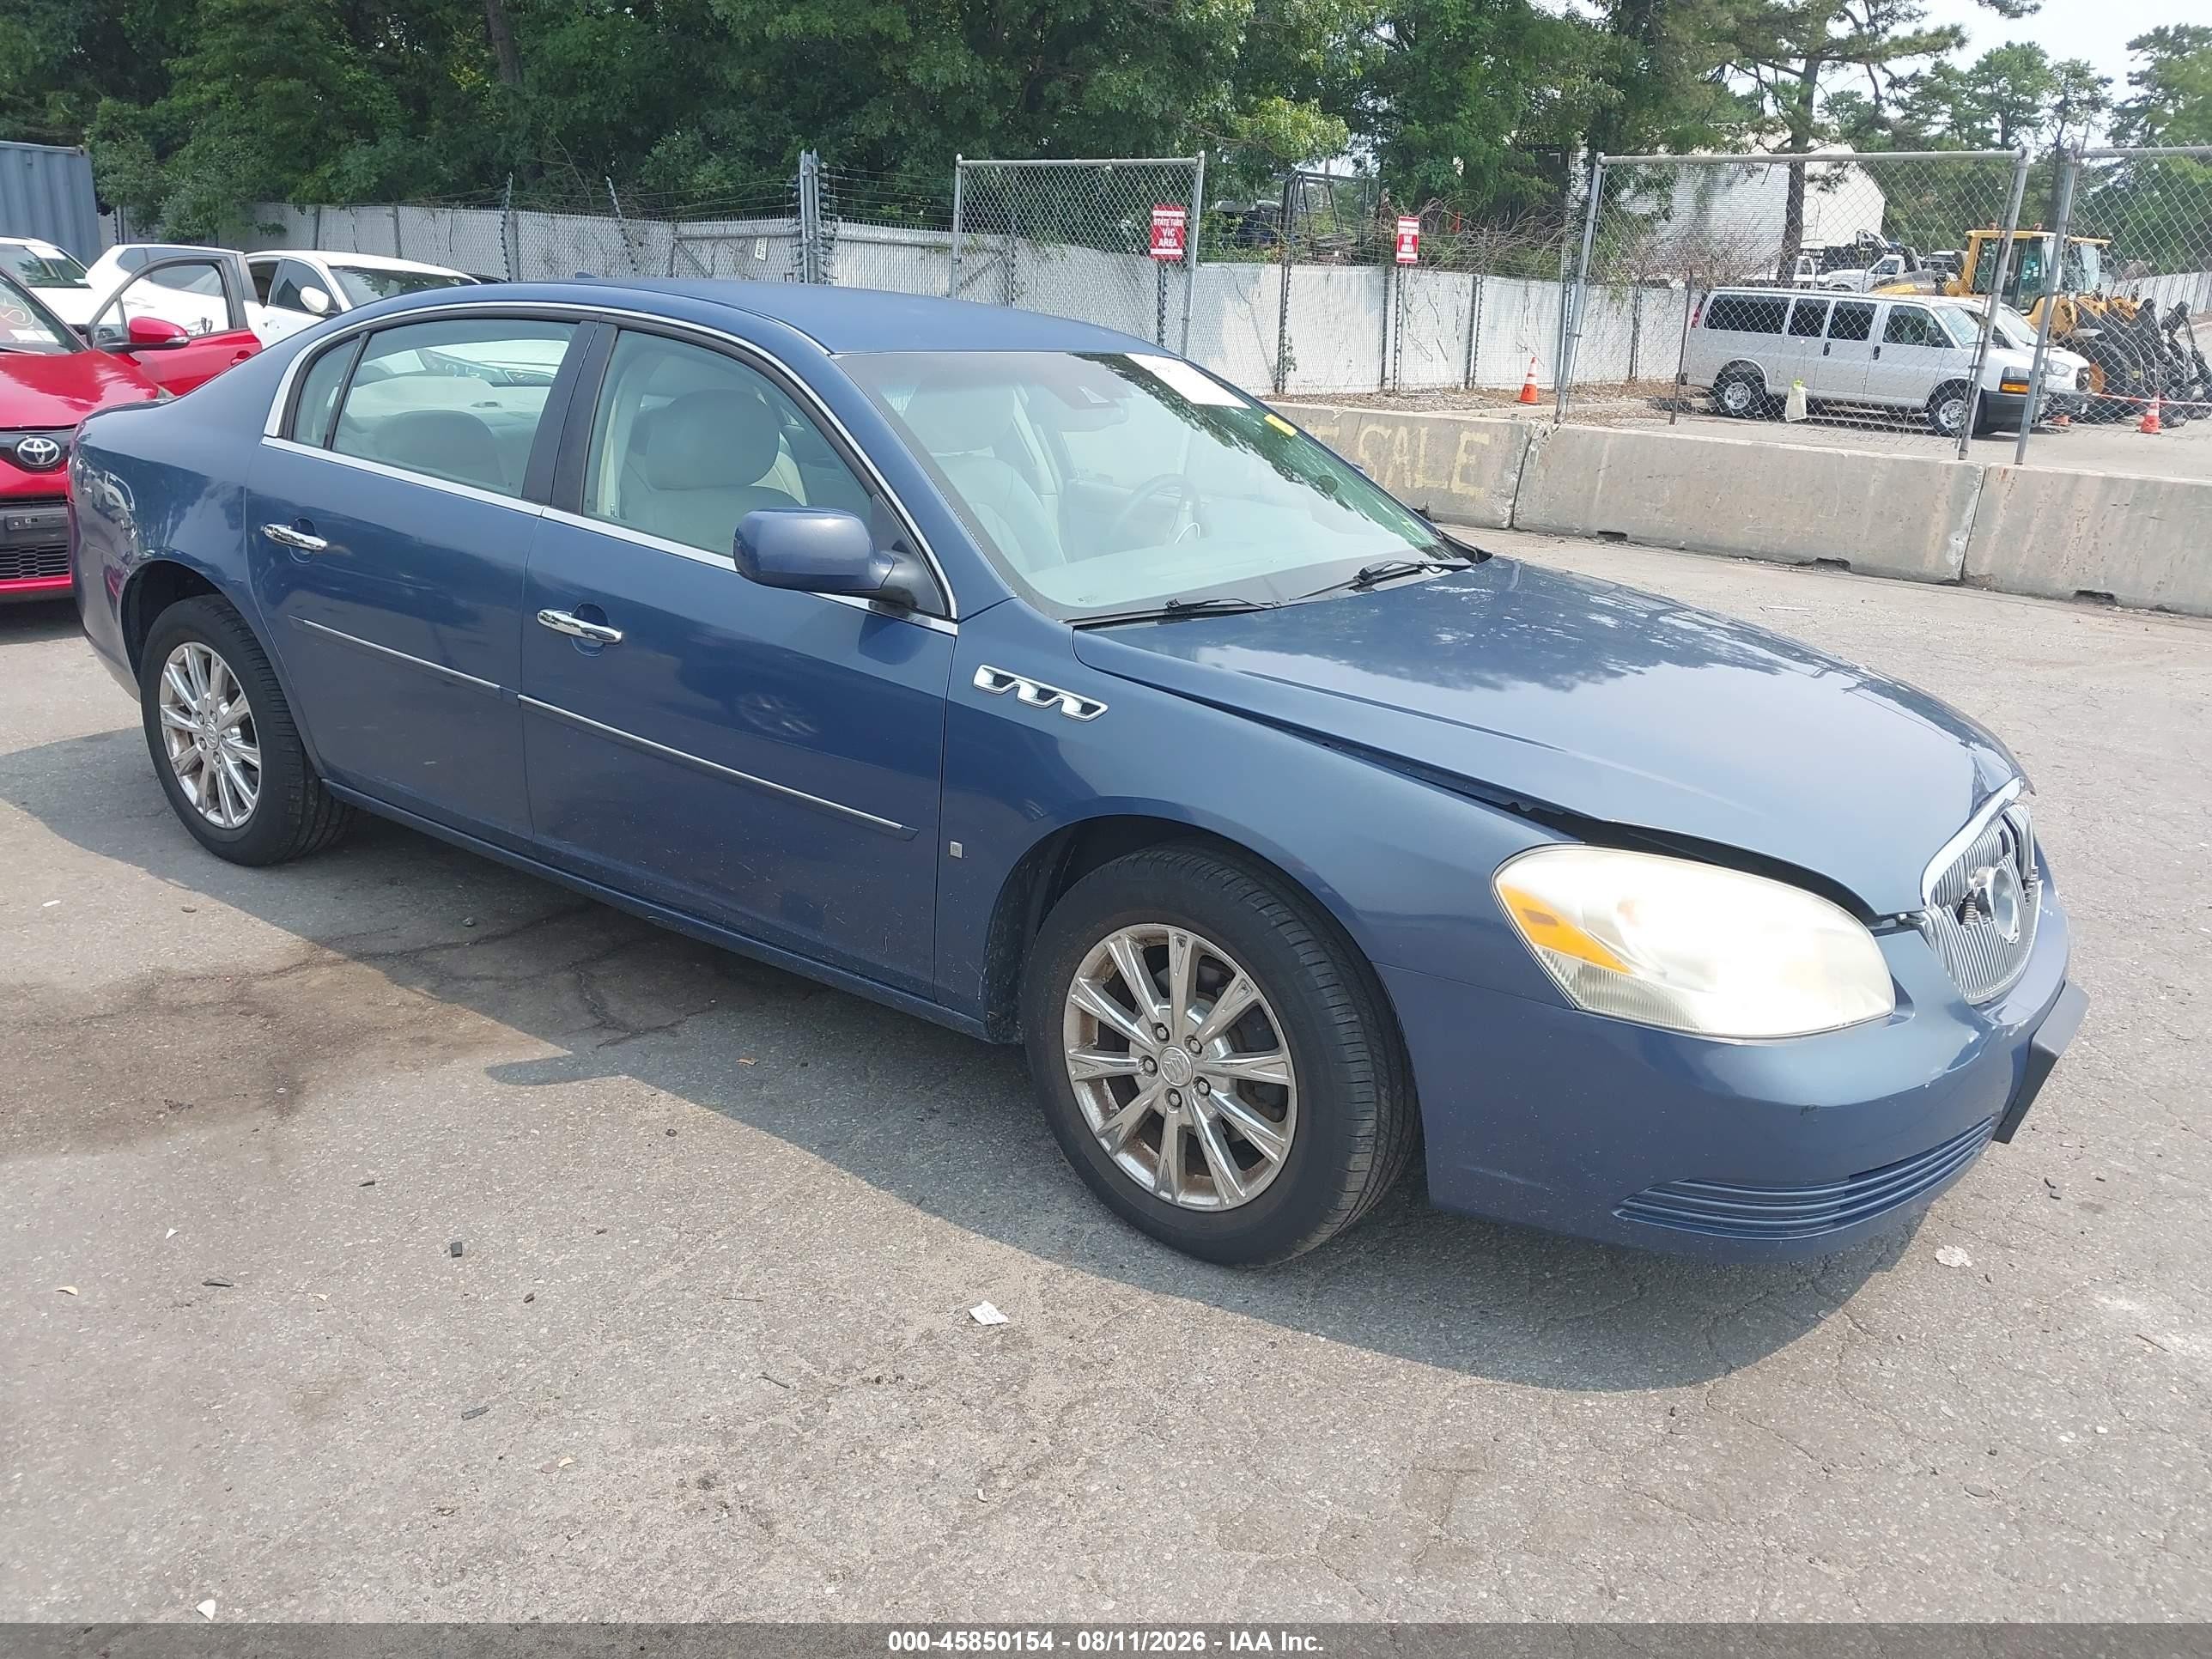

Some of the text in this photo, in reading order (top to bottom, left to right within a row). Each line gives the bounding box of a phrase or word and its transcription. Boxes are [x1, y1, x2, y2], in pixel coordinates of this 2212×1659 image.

[1162, 228, 1176, 237] VIC
[1158, 238, 1178, 247] AREA
[1358, 424, 1490, 496] SALE
